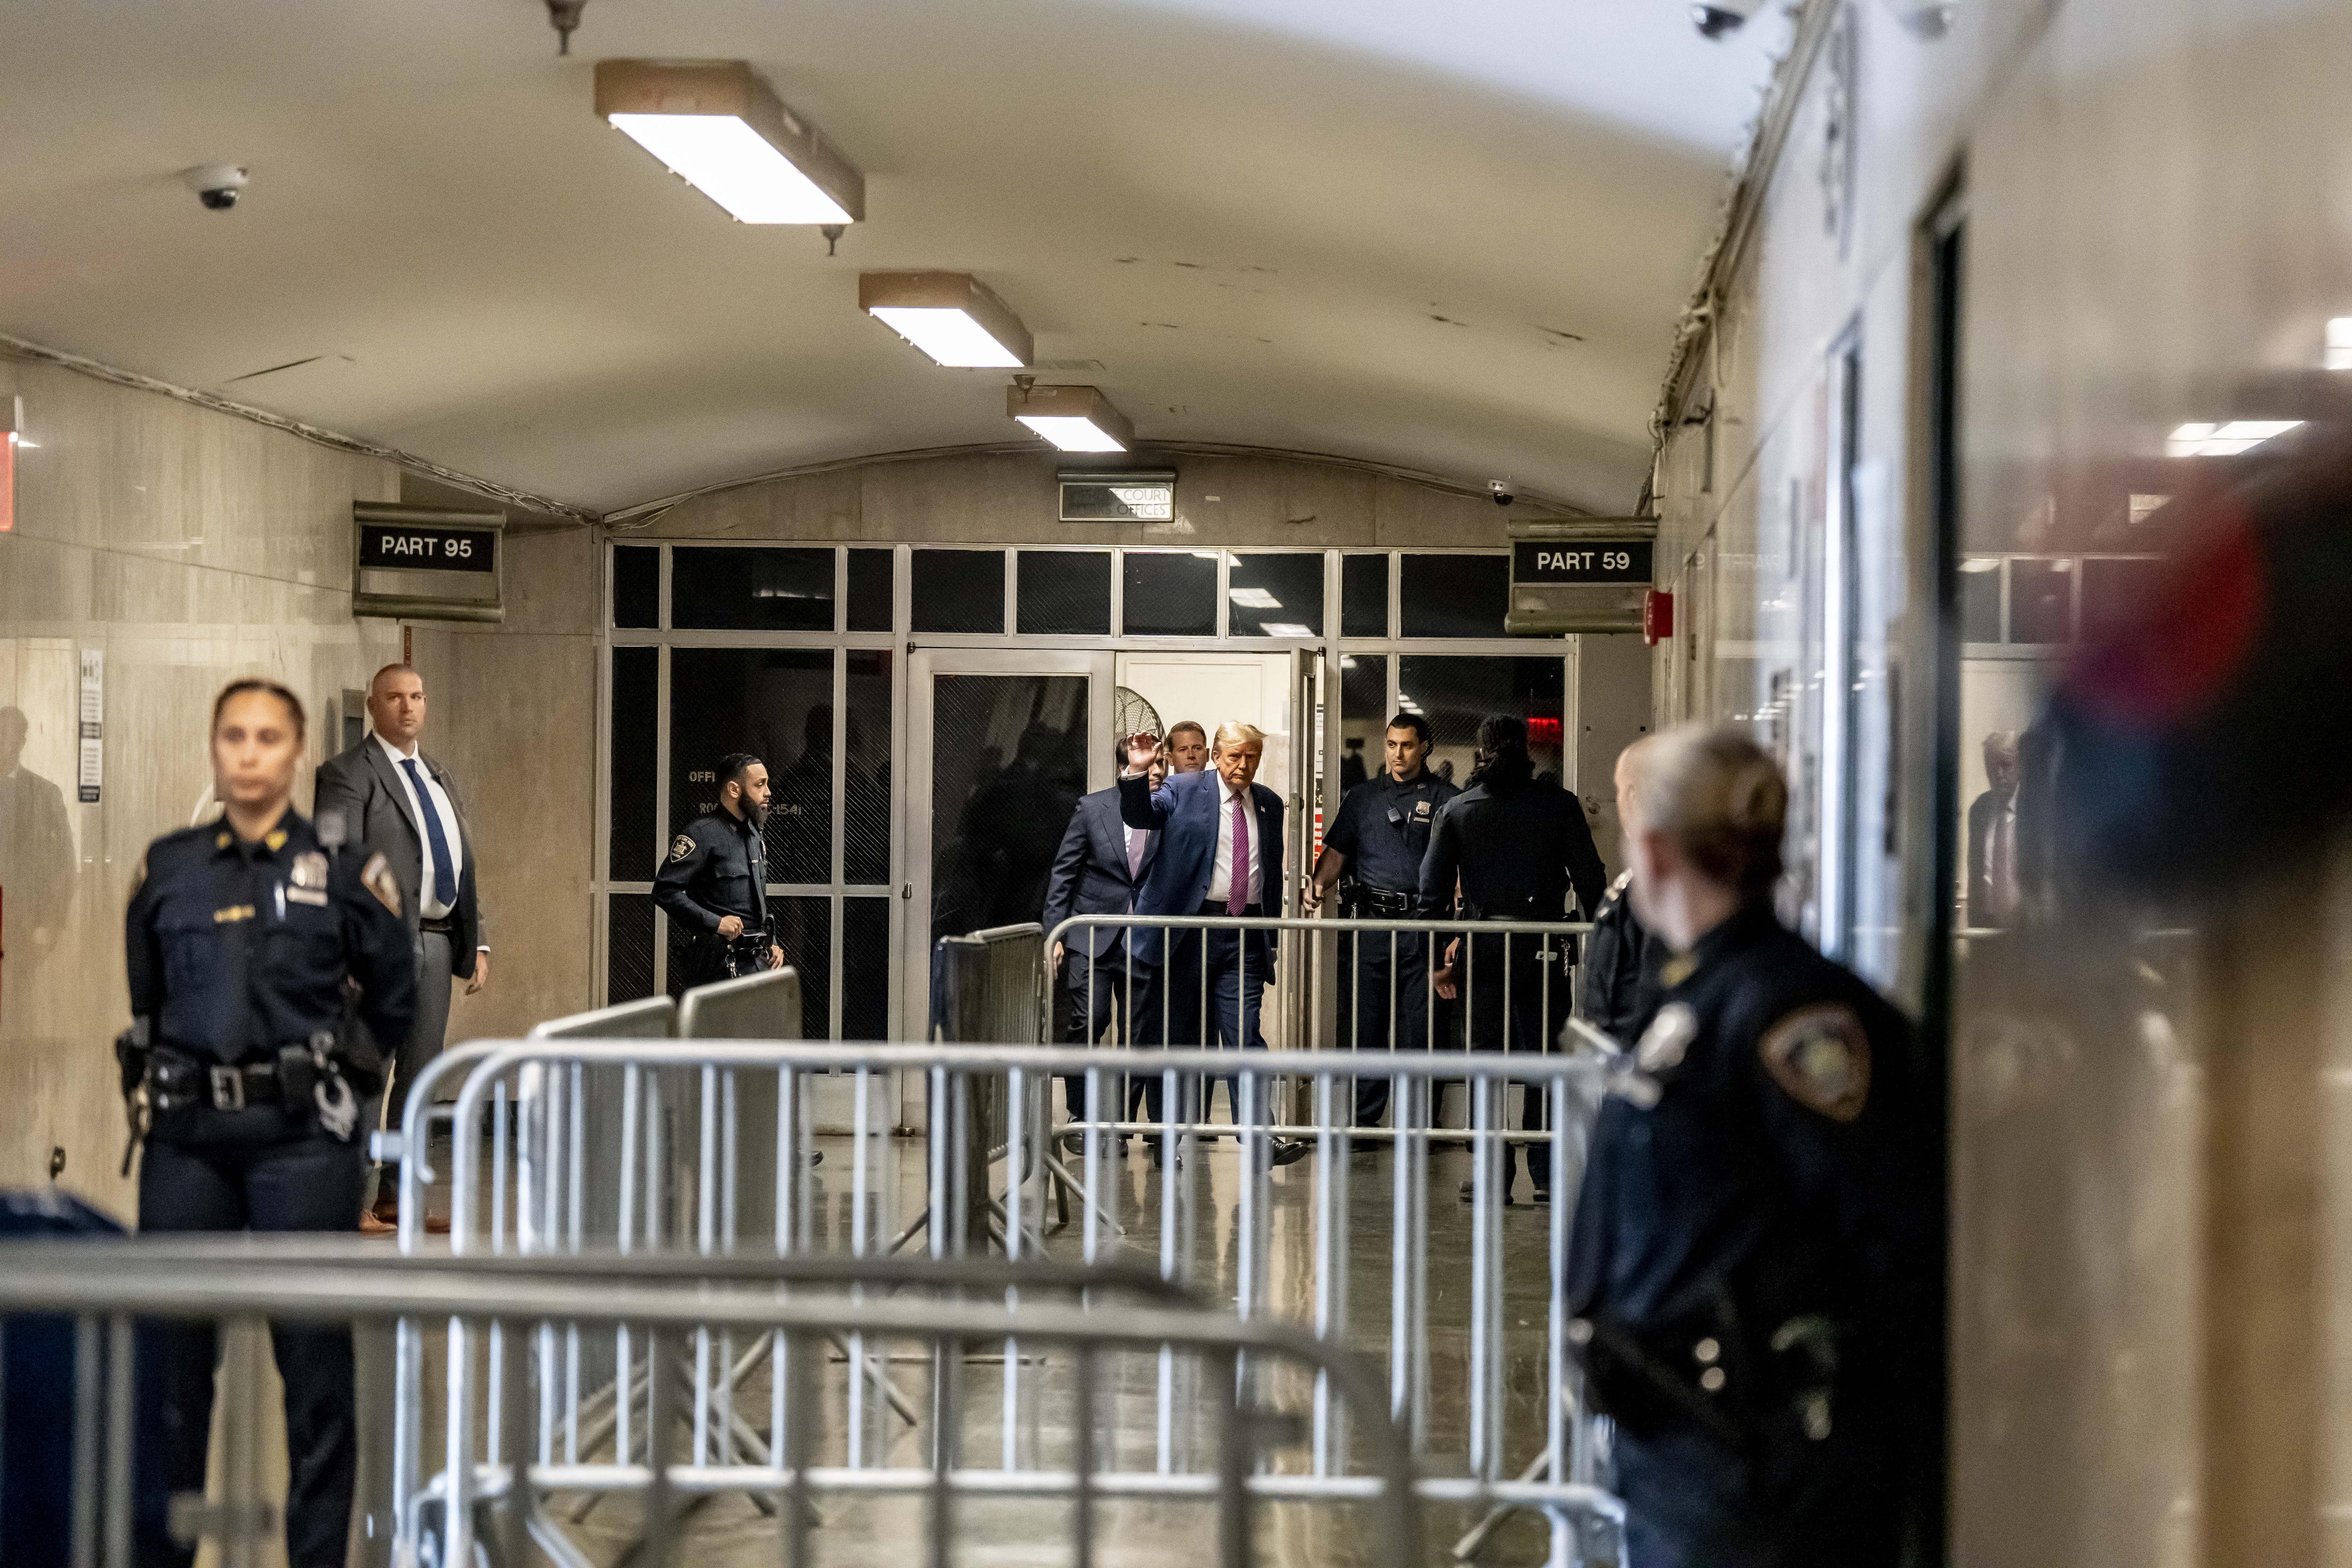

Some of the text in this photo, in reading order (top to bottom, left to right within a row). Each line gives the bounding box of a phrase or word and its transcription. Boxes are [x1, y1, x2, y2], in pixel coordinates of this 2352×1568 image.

[1124, 489, 1168, 501] COURT
[1117, 504, 1166, 516] OFFICES
[381, 535, 471, 557] PART 95
[1538, 552, 1630, 570] PART 59
[689, 771, 715, 782] OFFI
